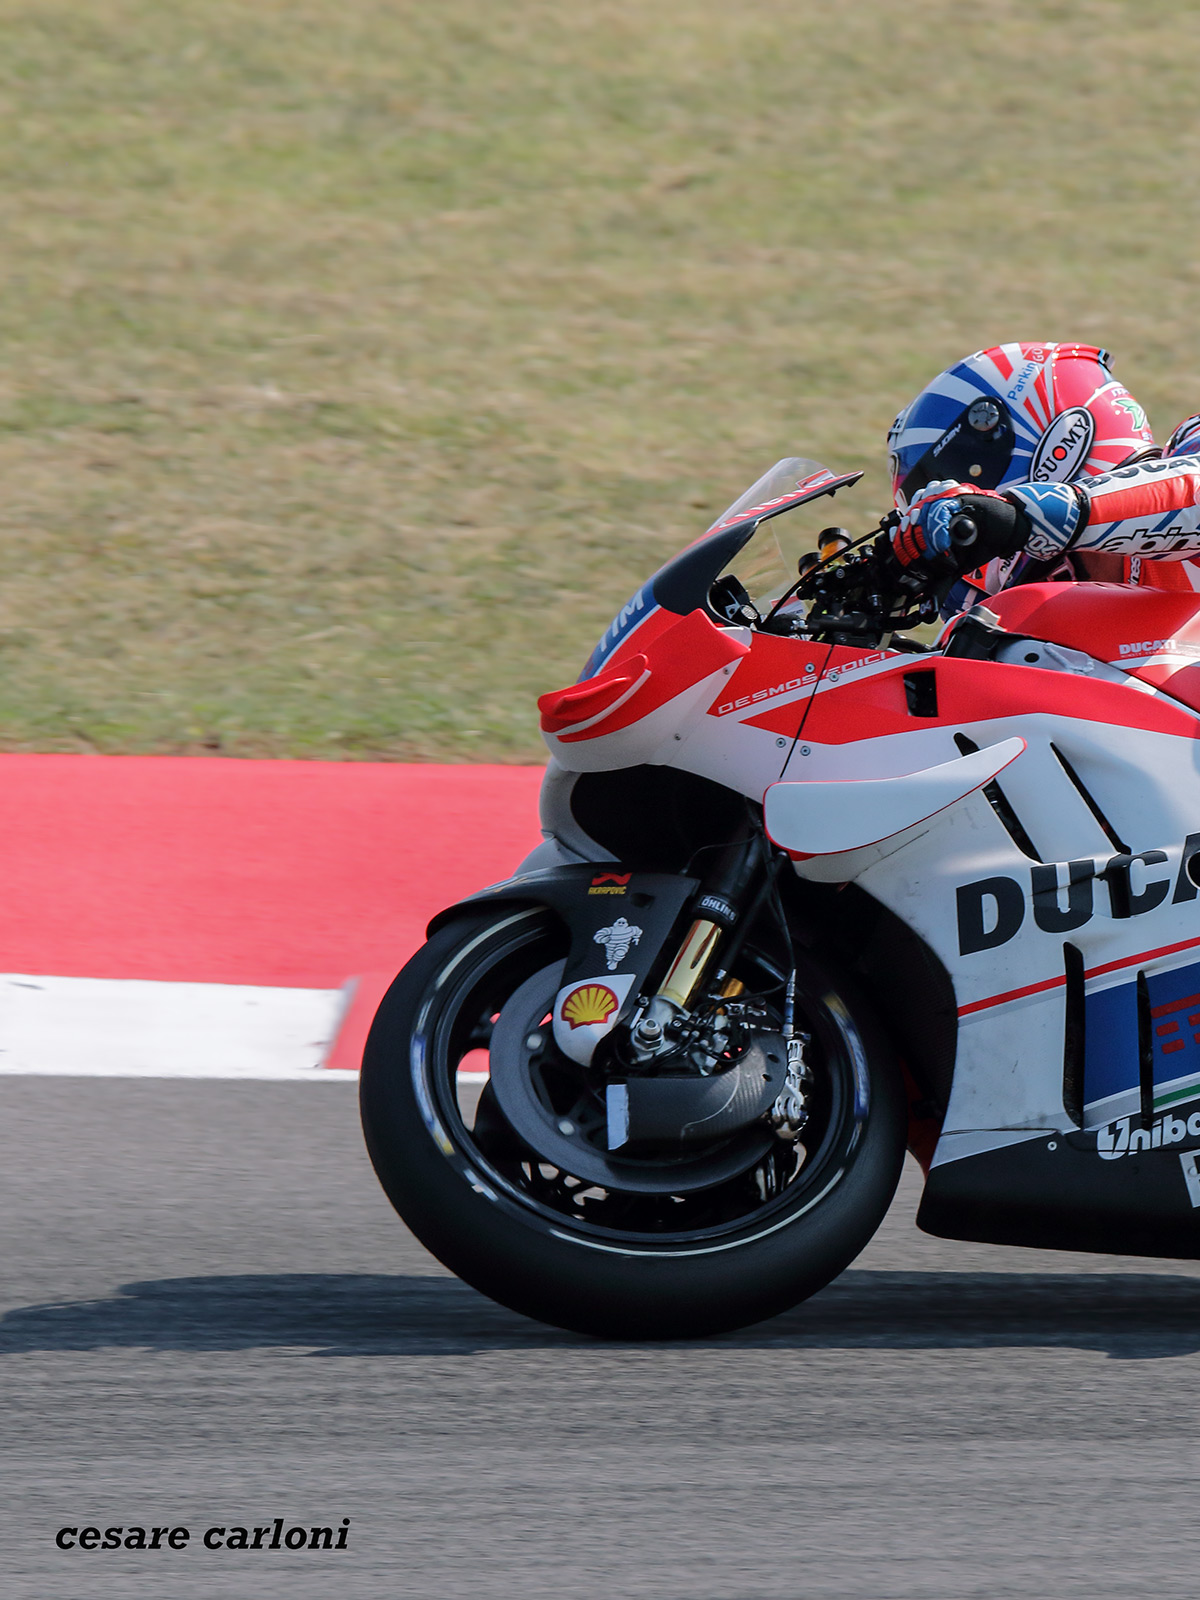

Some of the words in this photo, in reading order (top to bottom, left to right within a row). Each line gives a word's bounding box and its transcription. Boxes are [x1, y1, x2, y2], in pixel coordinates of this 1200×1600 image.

[1034, 417, 1091, 483] SUOMY
[1118, 638, 1177, 655] DUCATI
[717, 652, 887, 715] DESMOSEDICI
